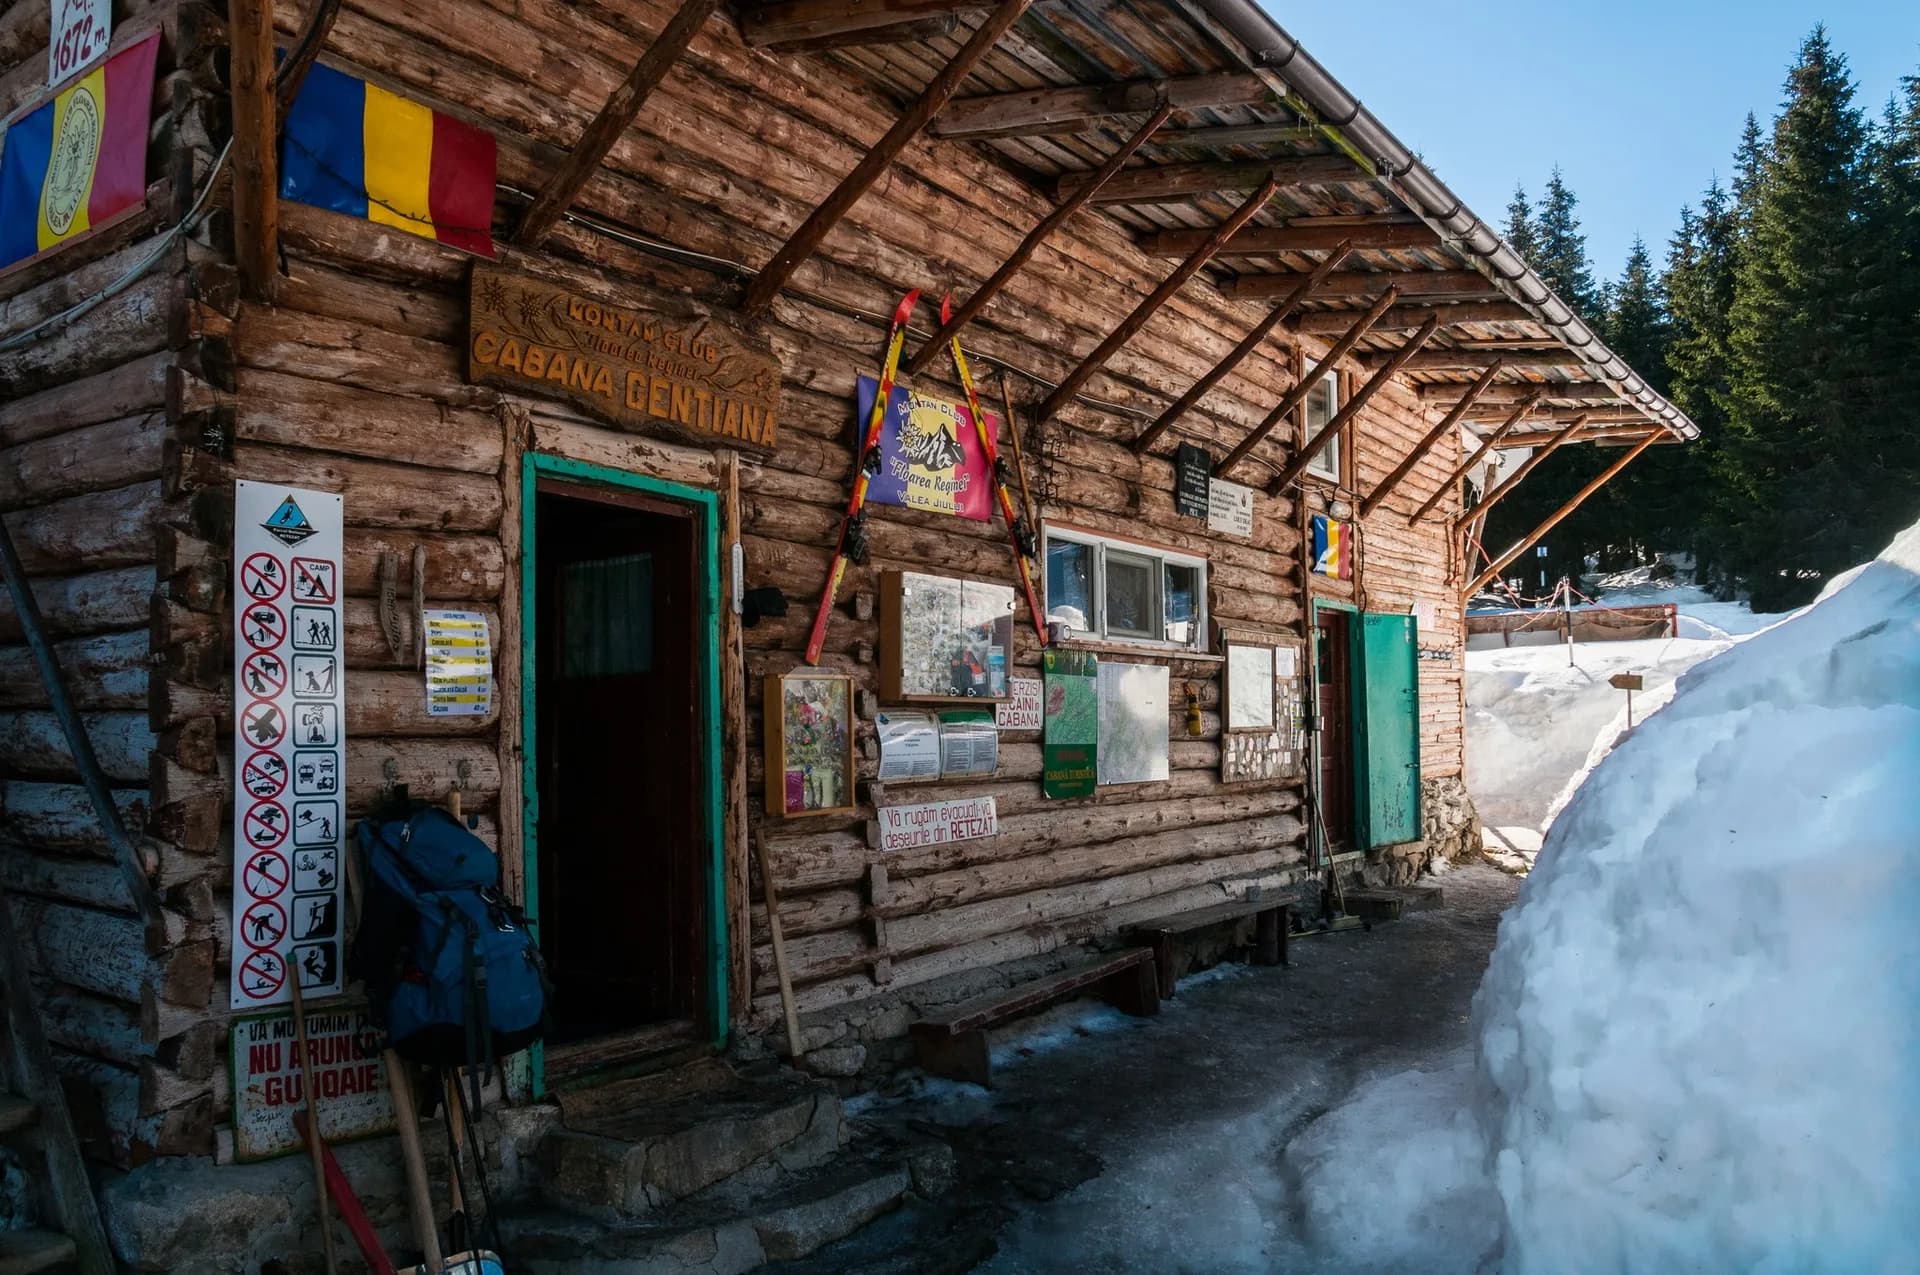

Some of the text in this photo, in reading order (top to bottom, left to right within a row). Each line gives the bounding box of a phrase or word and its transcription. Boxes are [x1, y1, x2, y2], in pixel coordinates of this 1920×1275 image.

[53, 14, 94, 80] 1672
[567, 298, 719, 364] MONTAN CLUB
[472, 332, 777, 448] CABANA GENTIANA
[897, 400, 966, 427] MONTAN CLUB
[897, 490, 964, 512] VALEA JIULUI
[309, 563, 330, 572] CAMP
[998, 711, 1040, 727] CABANA
[950, 816, 994, 840] RETEZAT
[250, 1044, 281, 1074] NU
